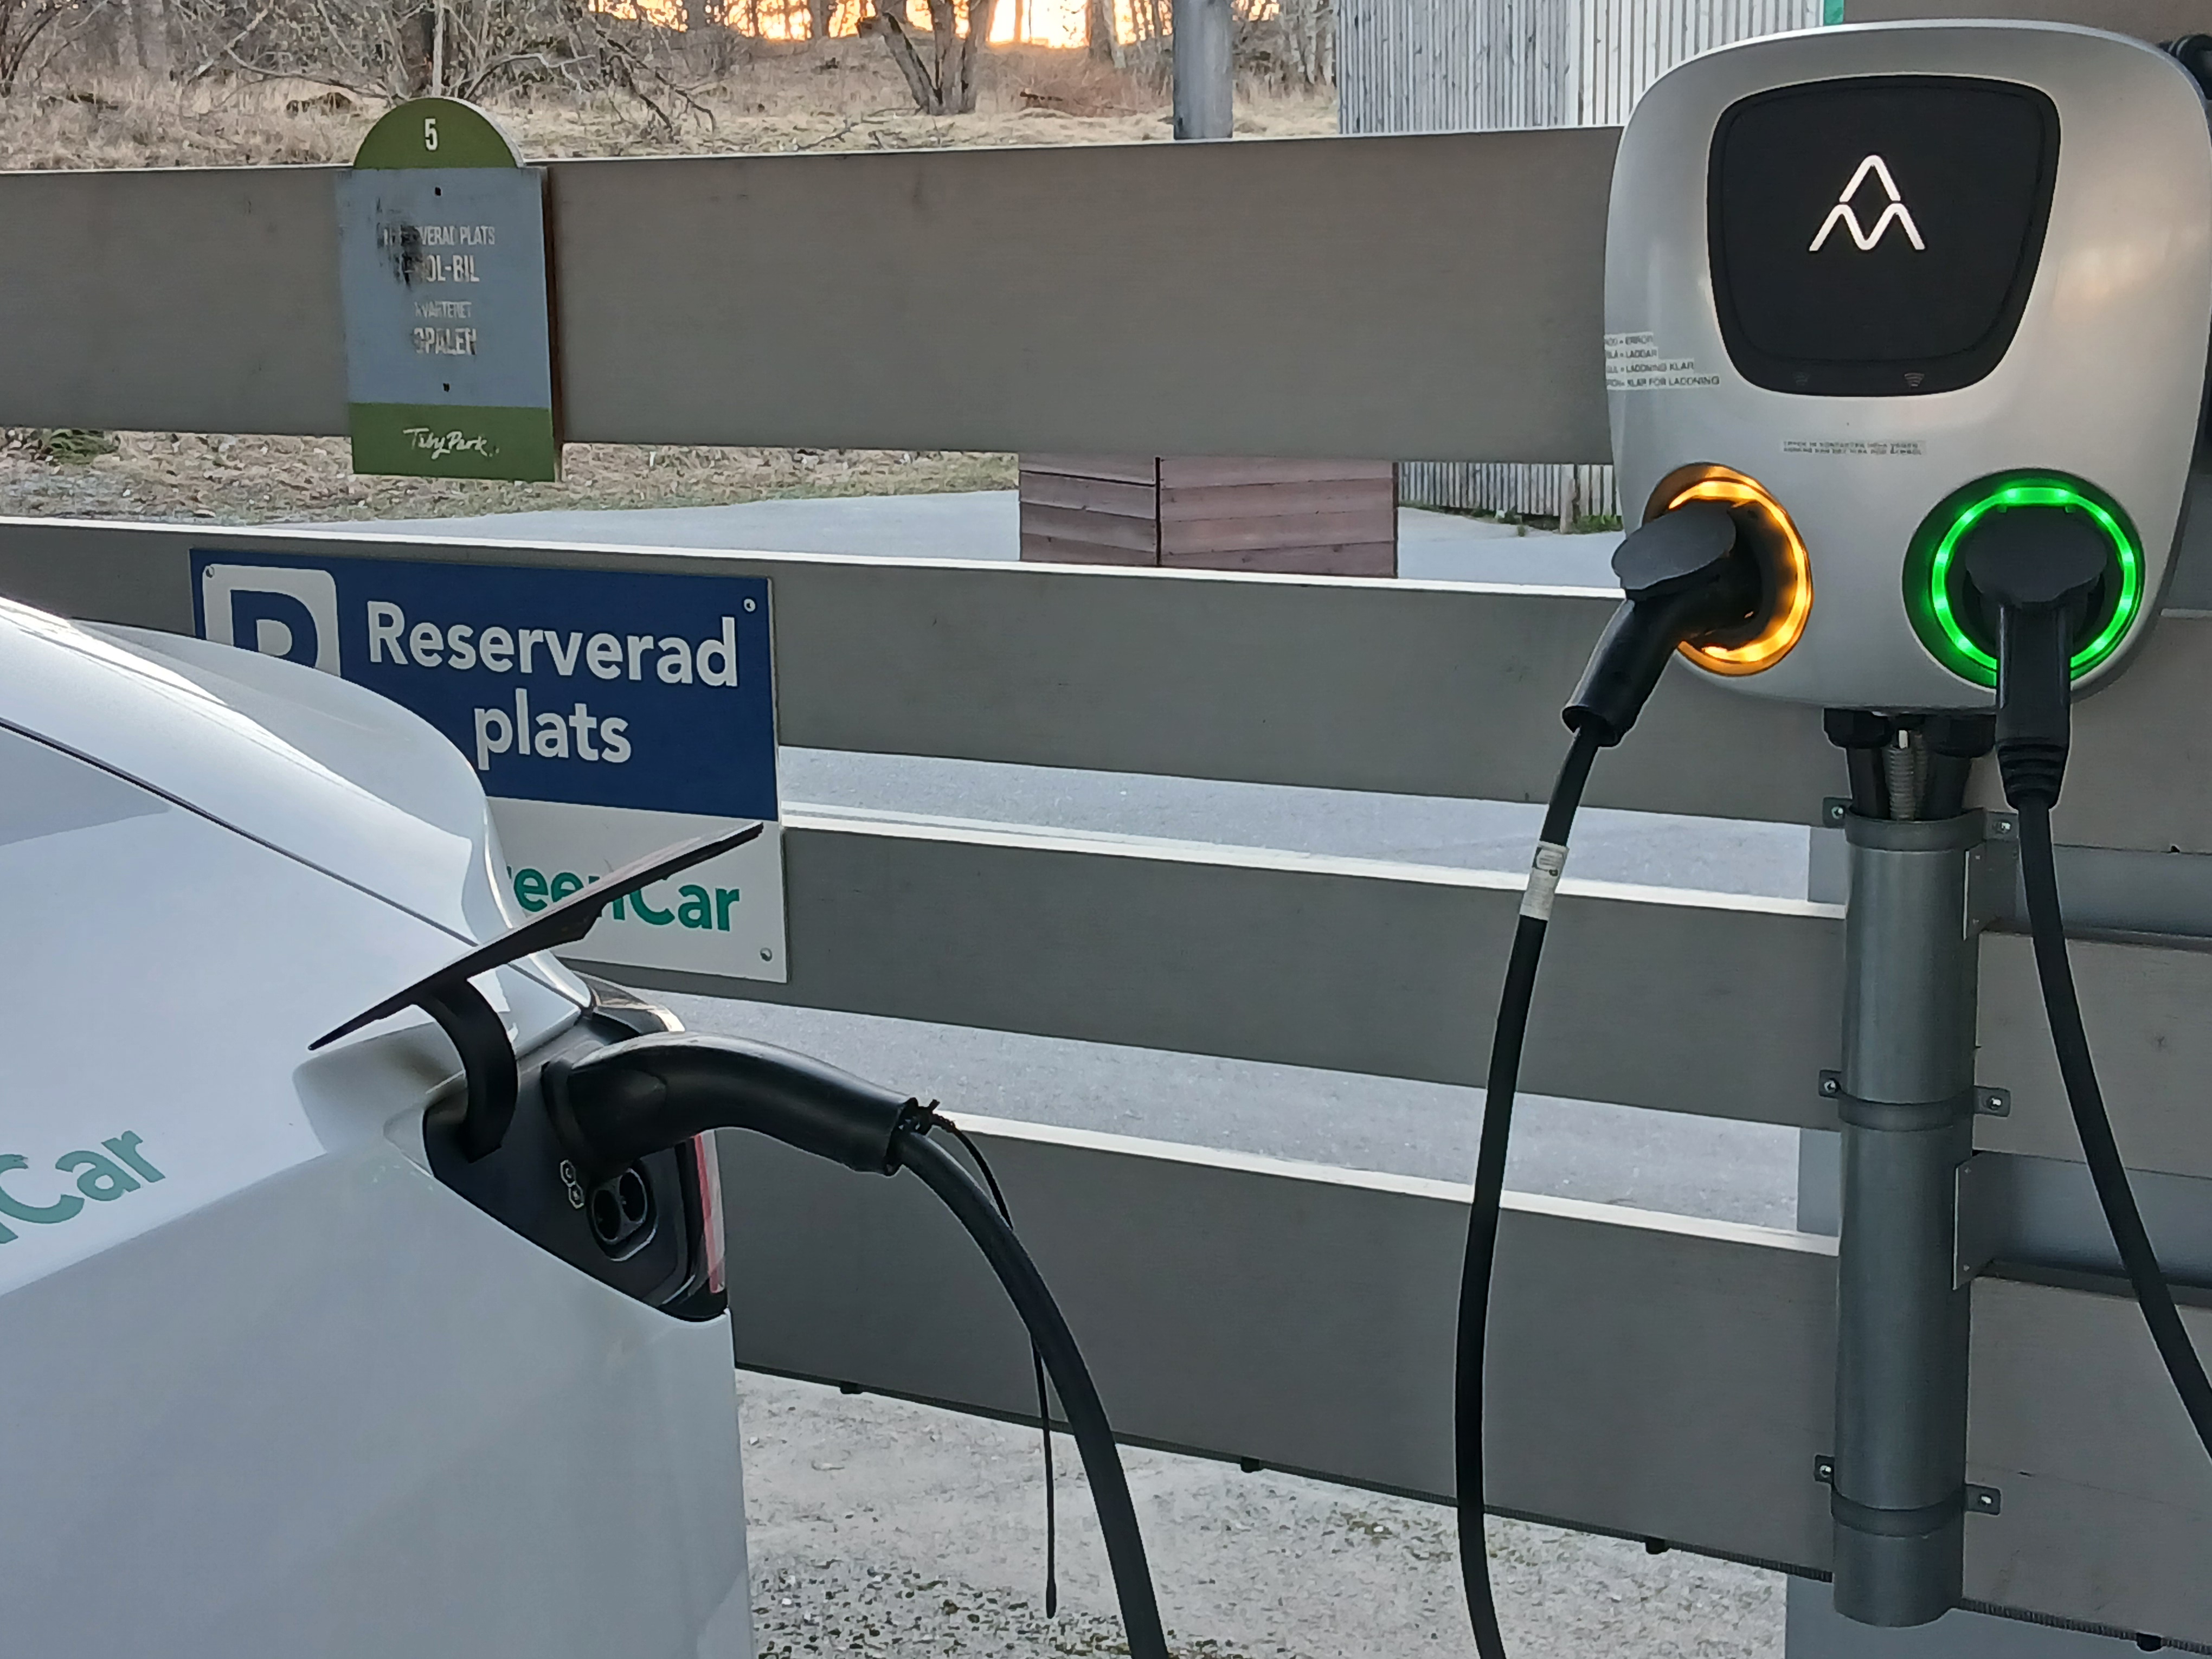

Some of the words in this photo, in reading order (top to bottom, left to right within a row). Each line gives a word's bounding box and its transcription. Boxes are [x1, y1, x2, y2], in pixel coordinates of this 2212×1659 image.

[425, 118, 438, 150] 5
[383, 225, 459, 246] VERAD
[460, 225, 495, 245] PLATS
[398, 255, 480, 282] OL-BIL
[367, 600, 738, 687] Reserverad
[473, 687, 632, 770] plats
[0, 1130, 165, 1244] Car
